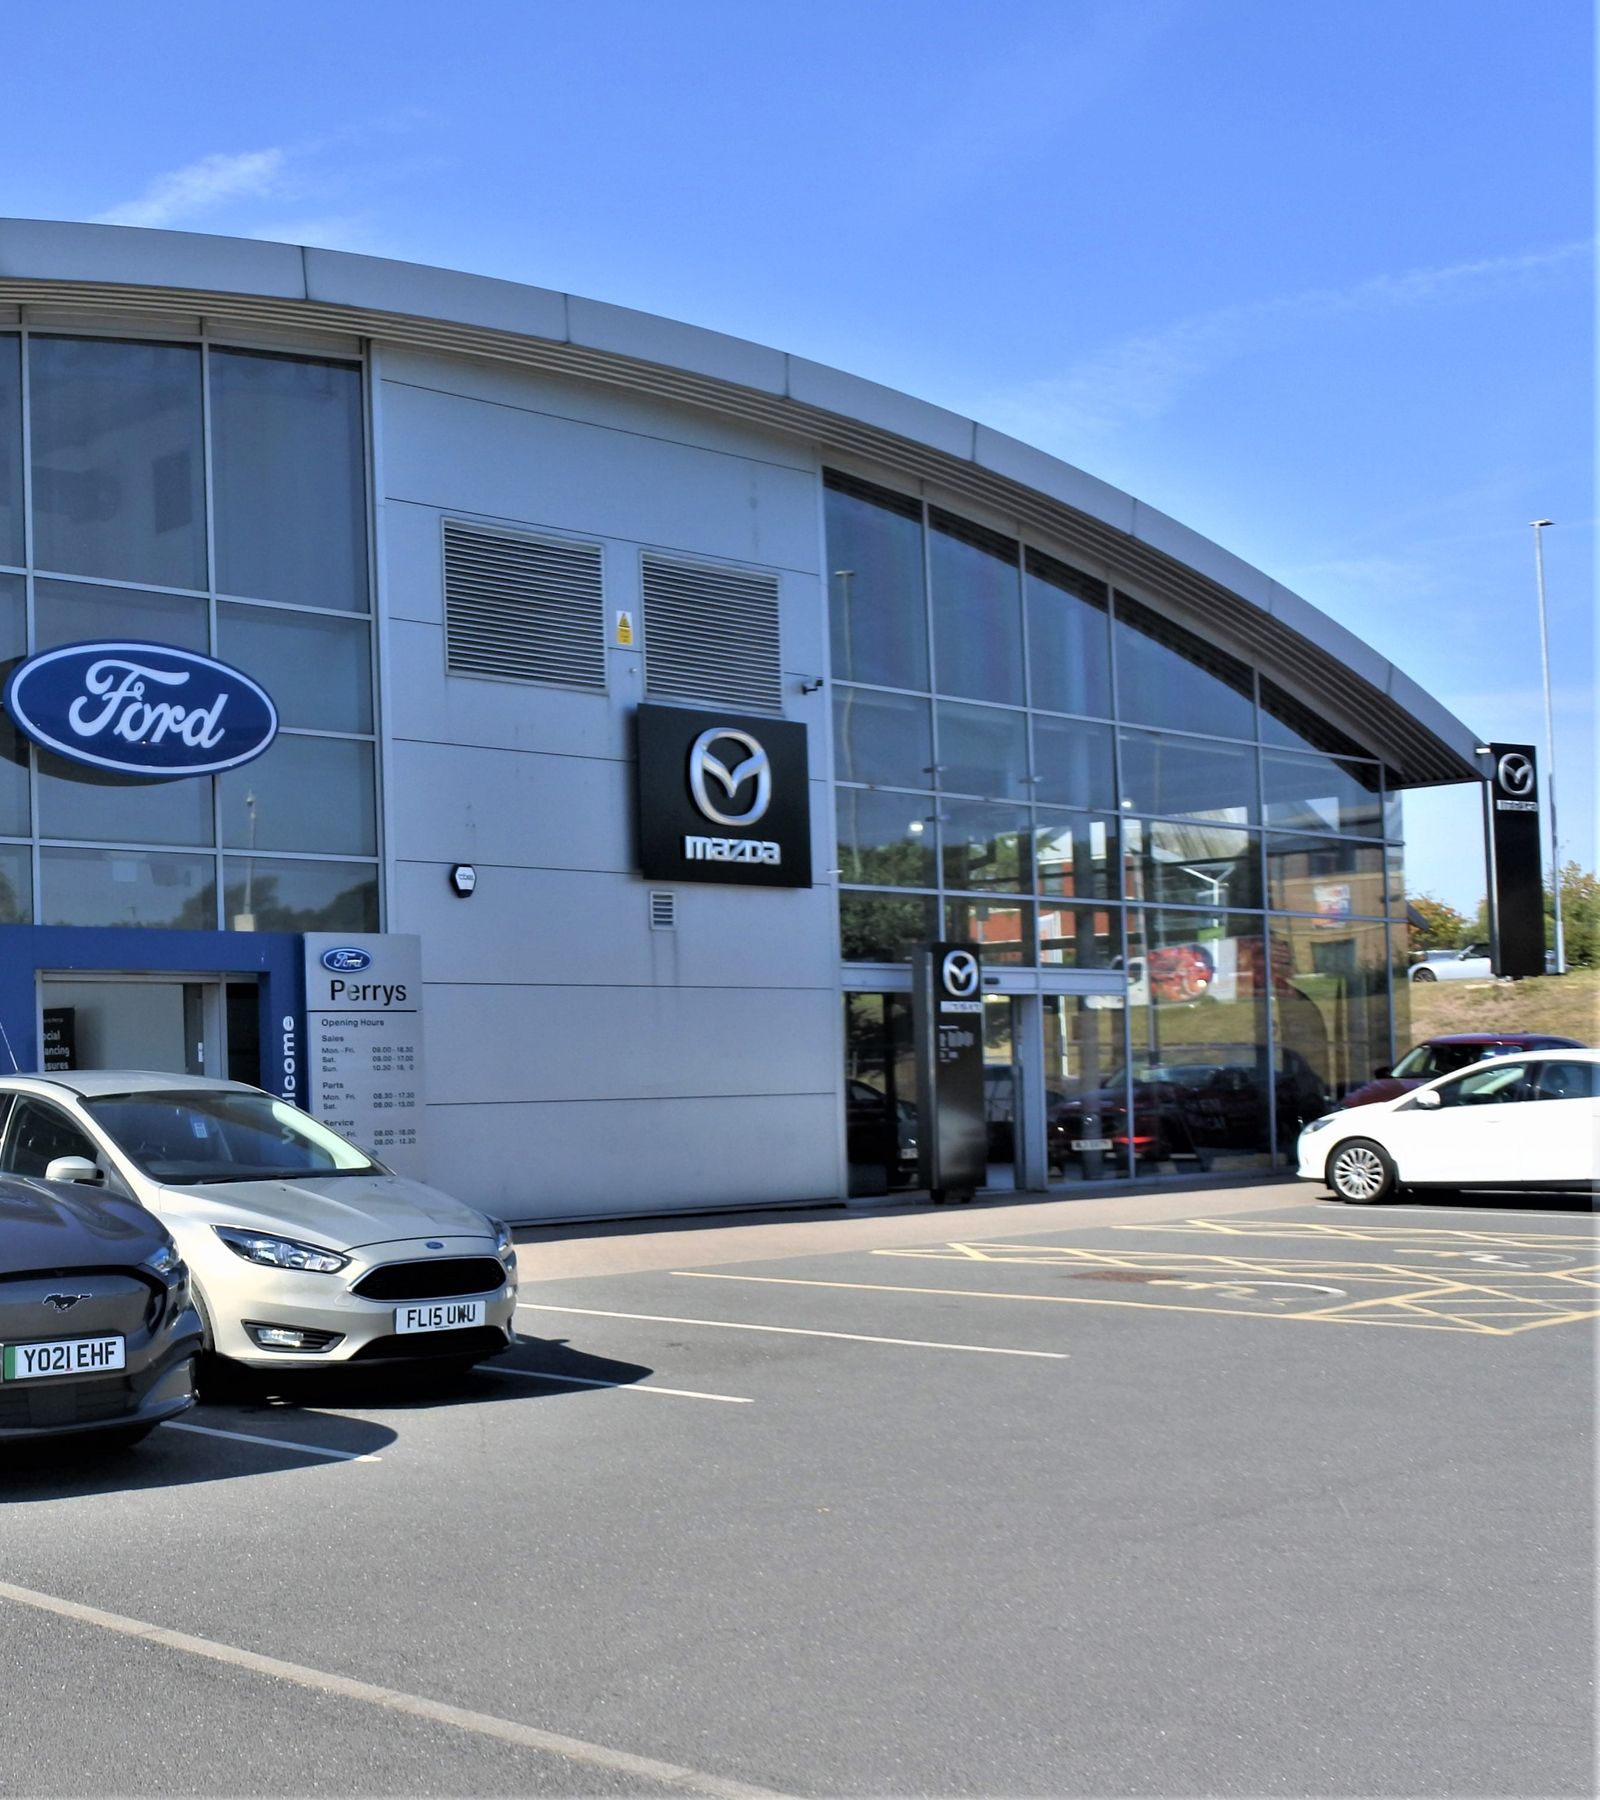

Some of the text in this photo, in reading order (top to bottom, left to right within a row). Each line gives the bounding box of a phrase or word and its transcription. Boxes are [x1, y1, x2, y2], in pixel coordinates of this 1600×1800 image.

[68, 659, 229, 749] Ford
[334, 951, 363, 967] Ford
[330, 979, 407, 1006] Perrys
[321, 1018, 385, 1028] Opening Hours
[321, 1034, 345, 1042] Sales
[322, 1081, 344, 1089] Parts
[323, 1119, 354, 1127] Service
[407, 1306, 443, 1329] FL15
[23, 1340, 117, 1373] YO21 EHF
